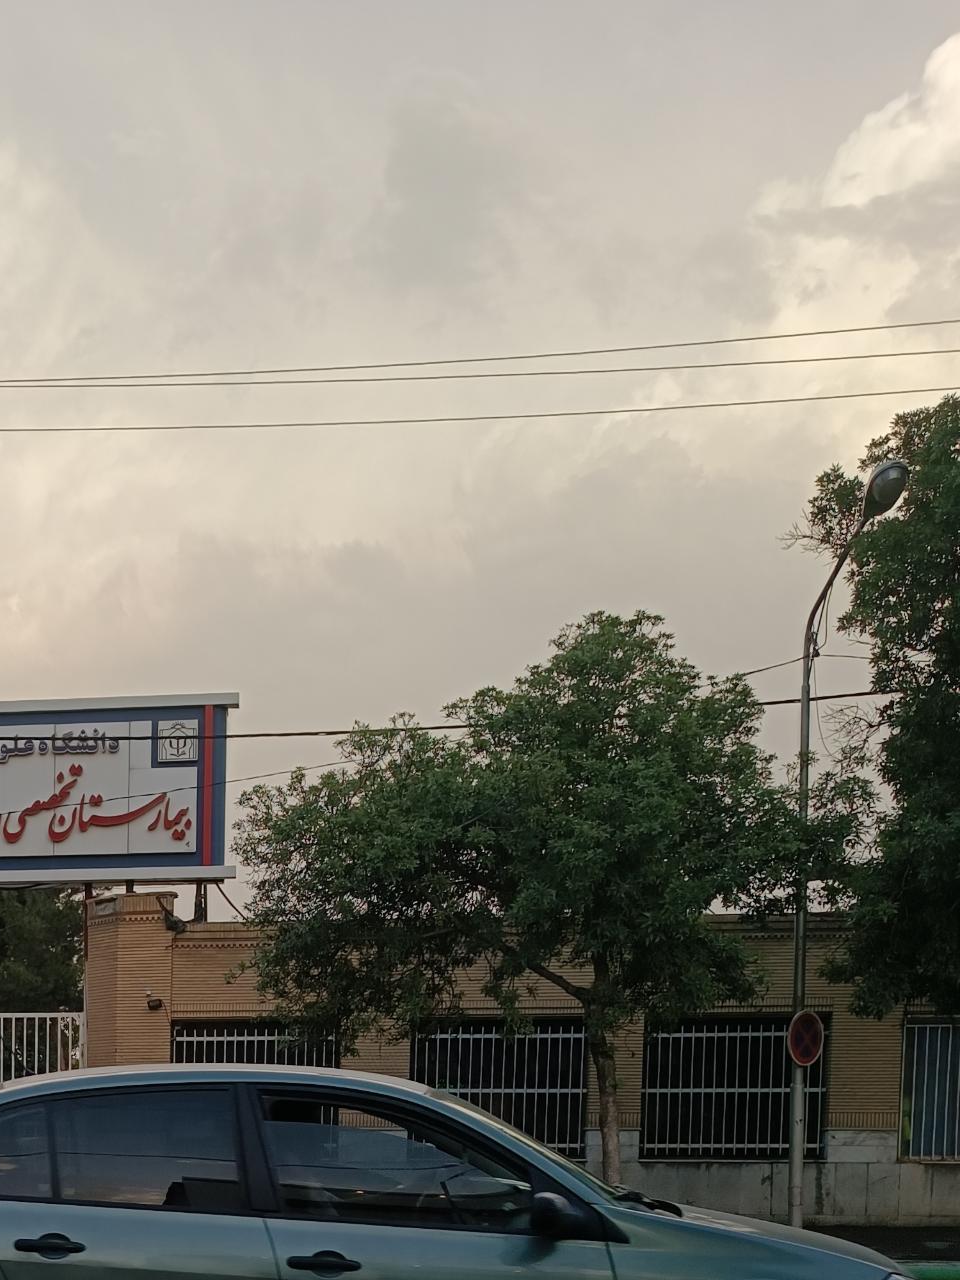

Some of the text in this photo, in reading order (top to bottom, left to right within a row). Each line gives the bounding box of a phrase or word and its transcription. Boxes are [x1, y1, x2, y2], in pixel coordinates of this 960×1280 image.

[38, 728, 120, 755] دانشگاه
[3, 764, 83, 844] تخصصی
[48, 792, 192, 843] بیمارستان
